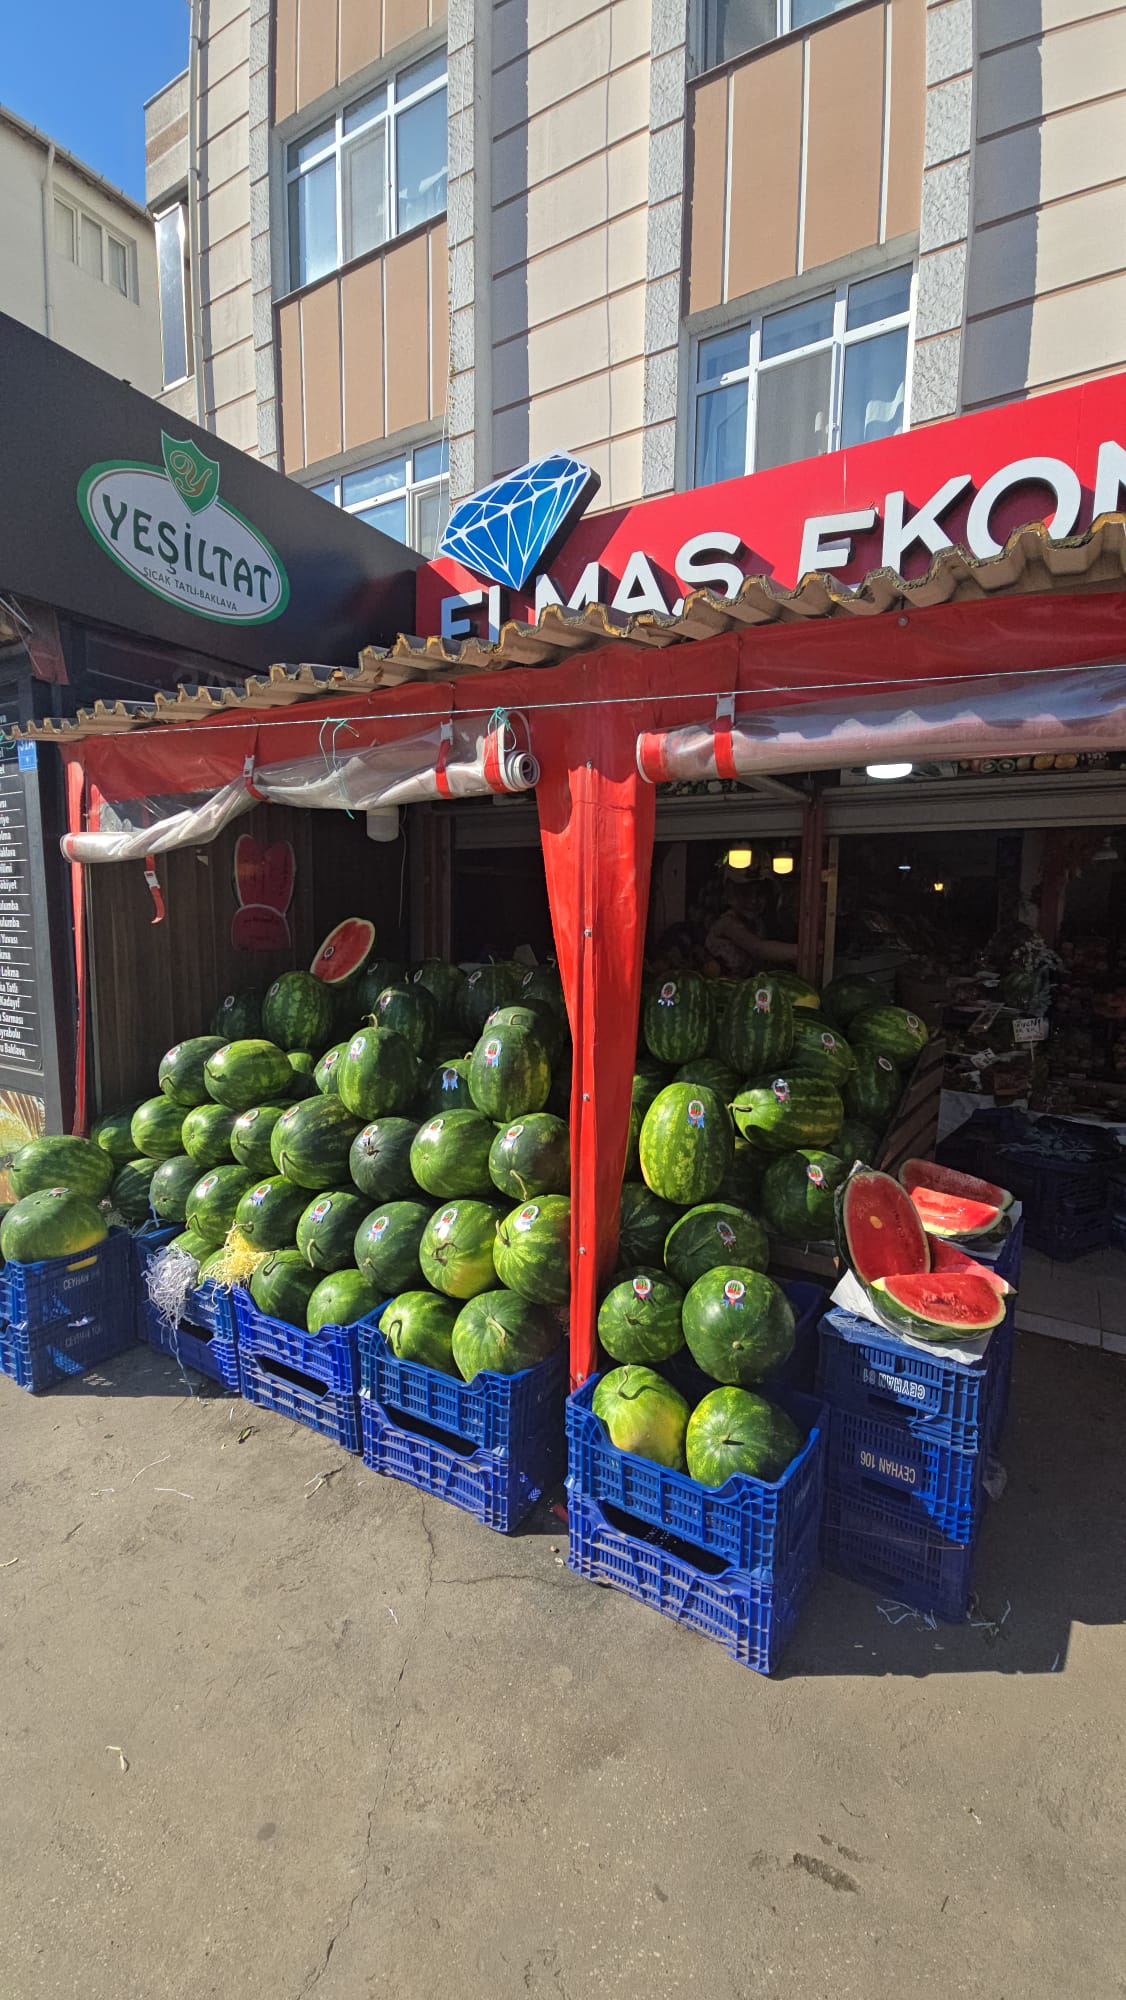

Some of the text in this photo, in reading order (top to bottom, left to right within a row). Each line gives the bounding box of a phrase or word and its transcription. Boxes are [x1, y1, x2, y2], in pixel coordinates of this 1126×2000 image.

[102, 493, 272, 604] YEŞİLTAT
[142, 566, 172, 588] SICAK
[0, 918, 20, 928] ulumba
[878, 1372, 926, 1400] CEYHAN
[860, 1450, 916, 1485] CEYHAN 106
